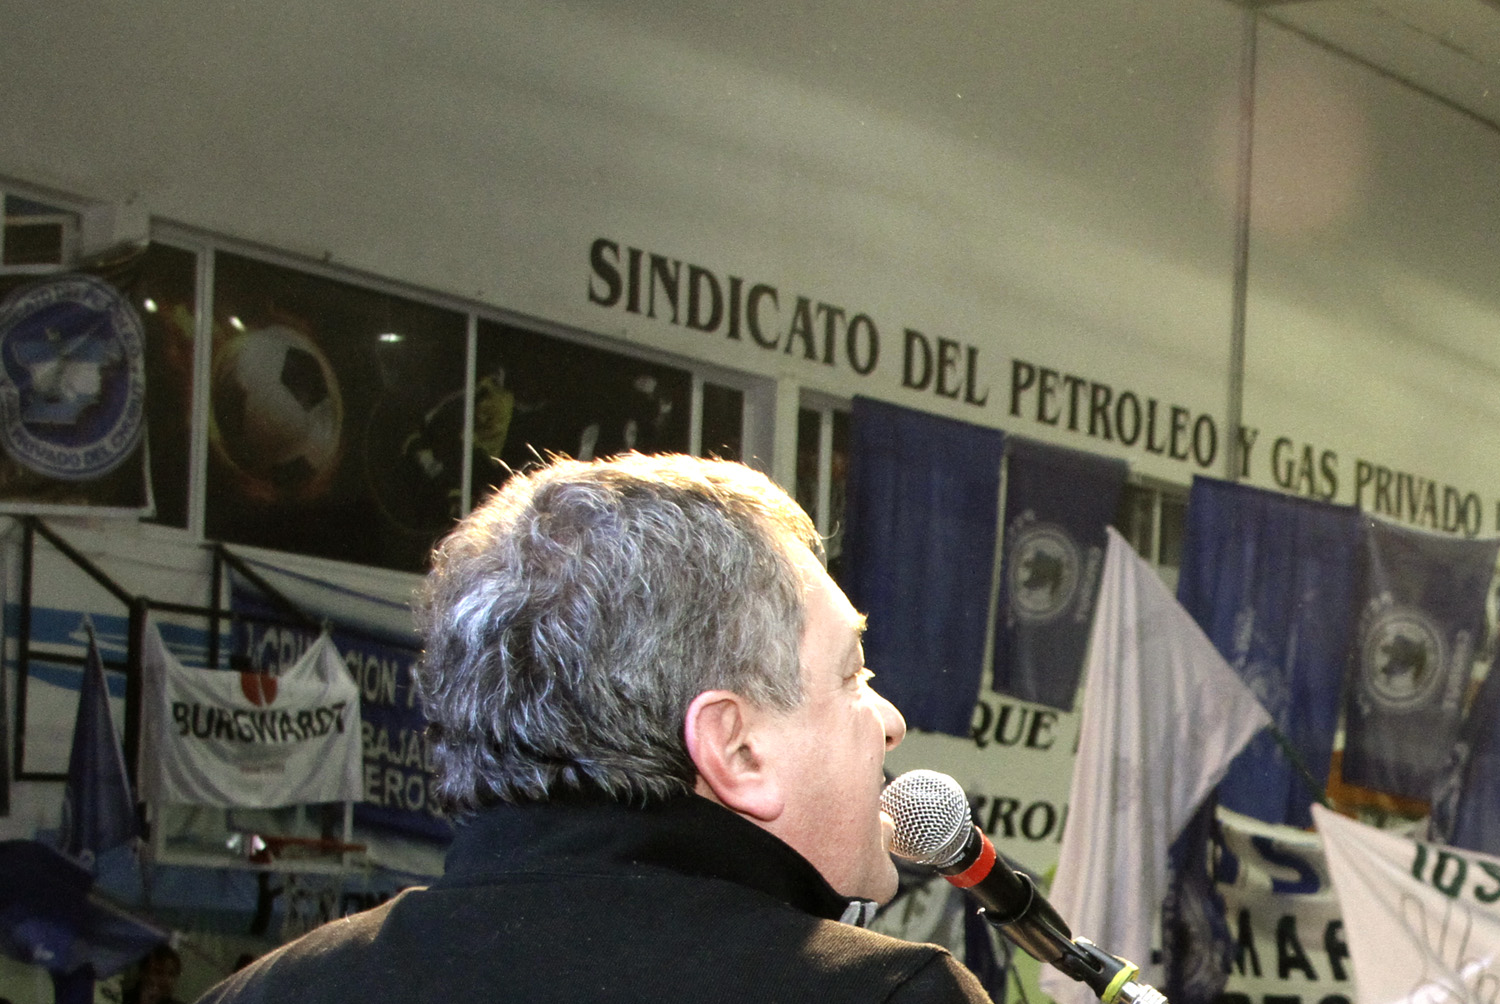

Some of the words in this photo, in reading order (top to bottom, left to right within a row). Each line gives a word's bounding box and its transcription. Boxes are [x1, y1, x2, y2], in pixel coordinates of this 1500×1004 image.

[588, 238, 881, 377] SINDICATO
[901, 328, 989, 407] DEL
[1009, 358, 1218, 468] PETROLEO
[1236, 425, 1260, 478] Y
[1271, 436, 1339, 502] GAS
[1355, 458, 1483, 539] PRIVADO
